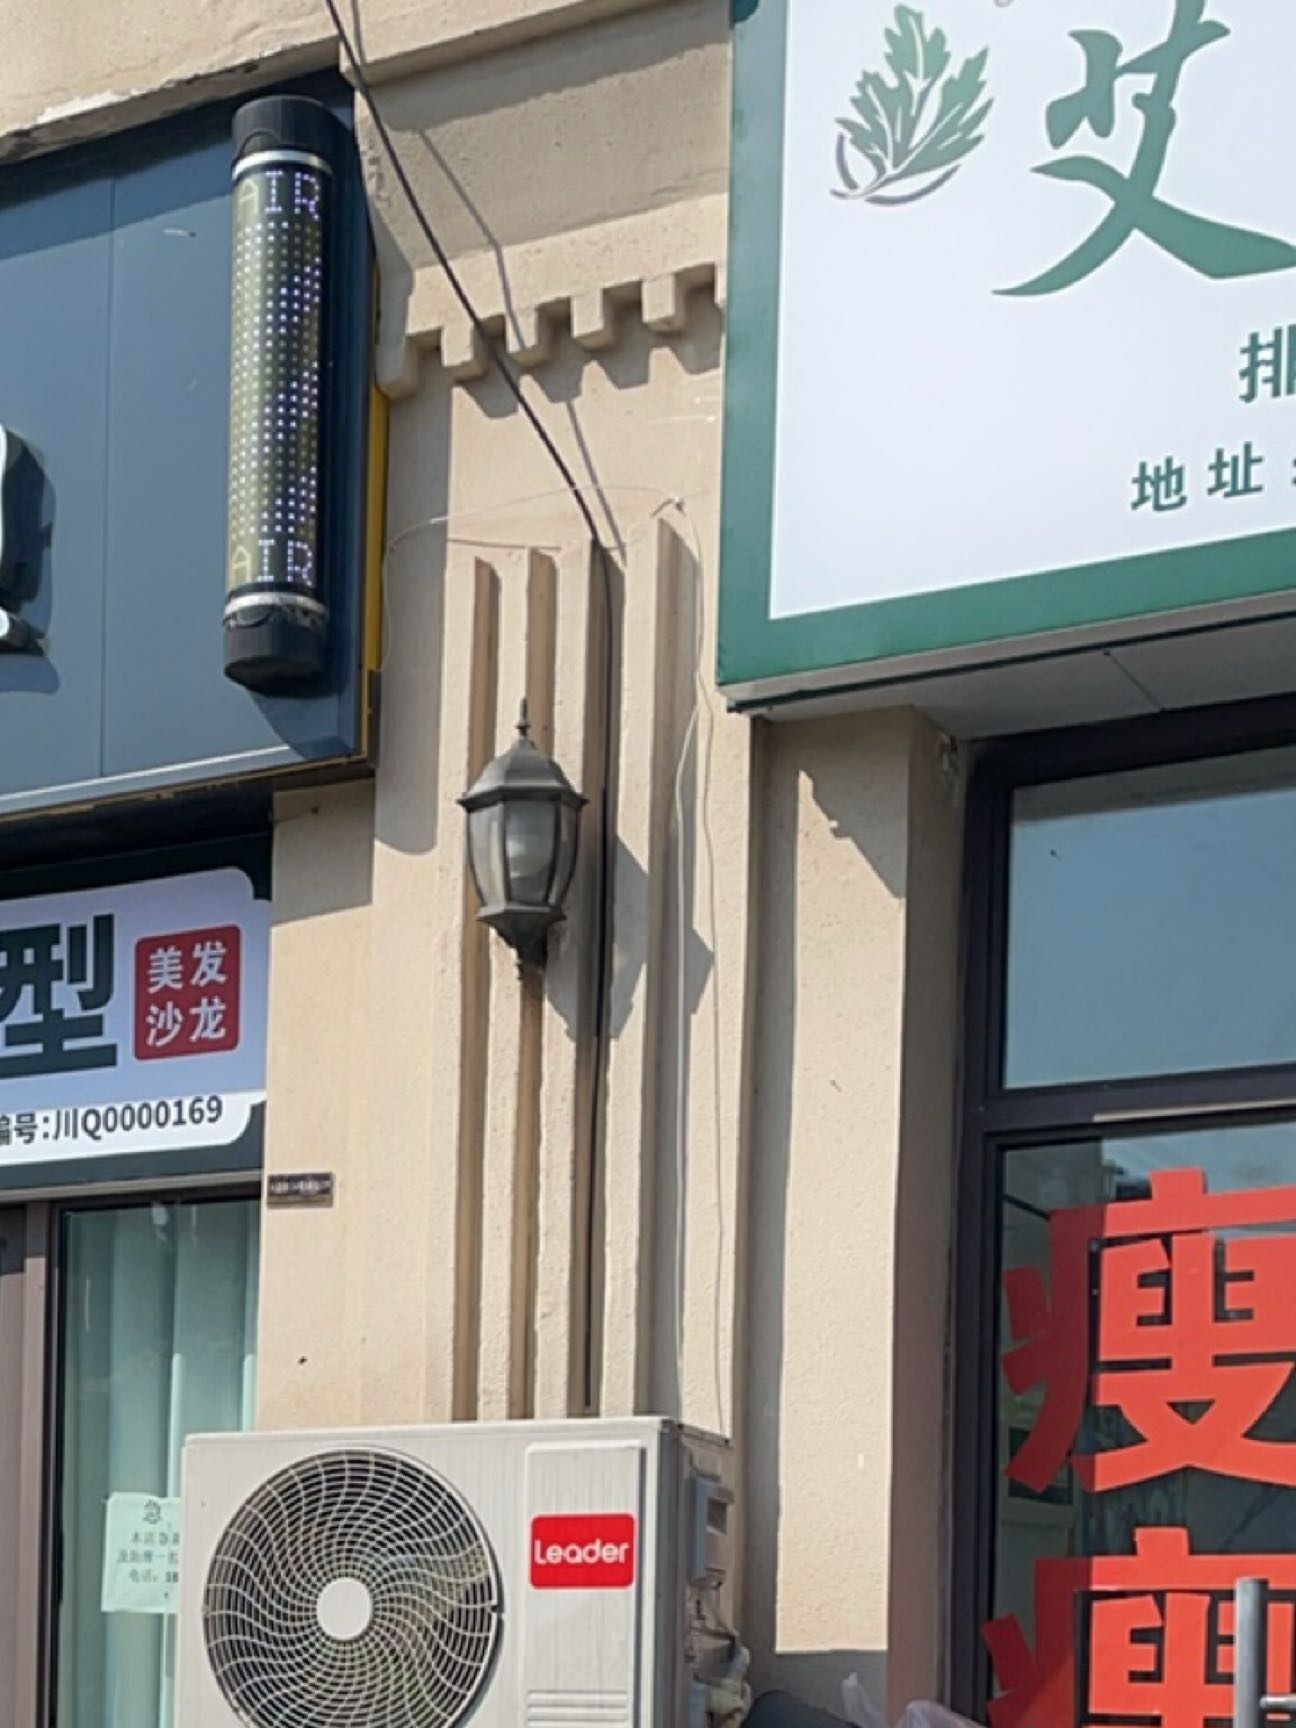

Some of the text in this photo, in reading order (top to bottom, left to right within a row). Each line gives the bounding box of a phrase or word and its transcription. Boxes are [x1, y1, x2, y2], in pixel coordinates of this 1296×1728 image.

[147, 939, 227, 994] 美发
[146, 995, 227, 1048] 沙龙
[533, 1538, 629, 1565] Leader
